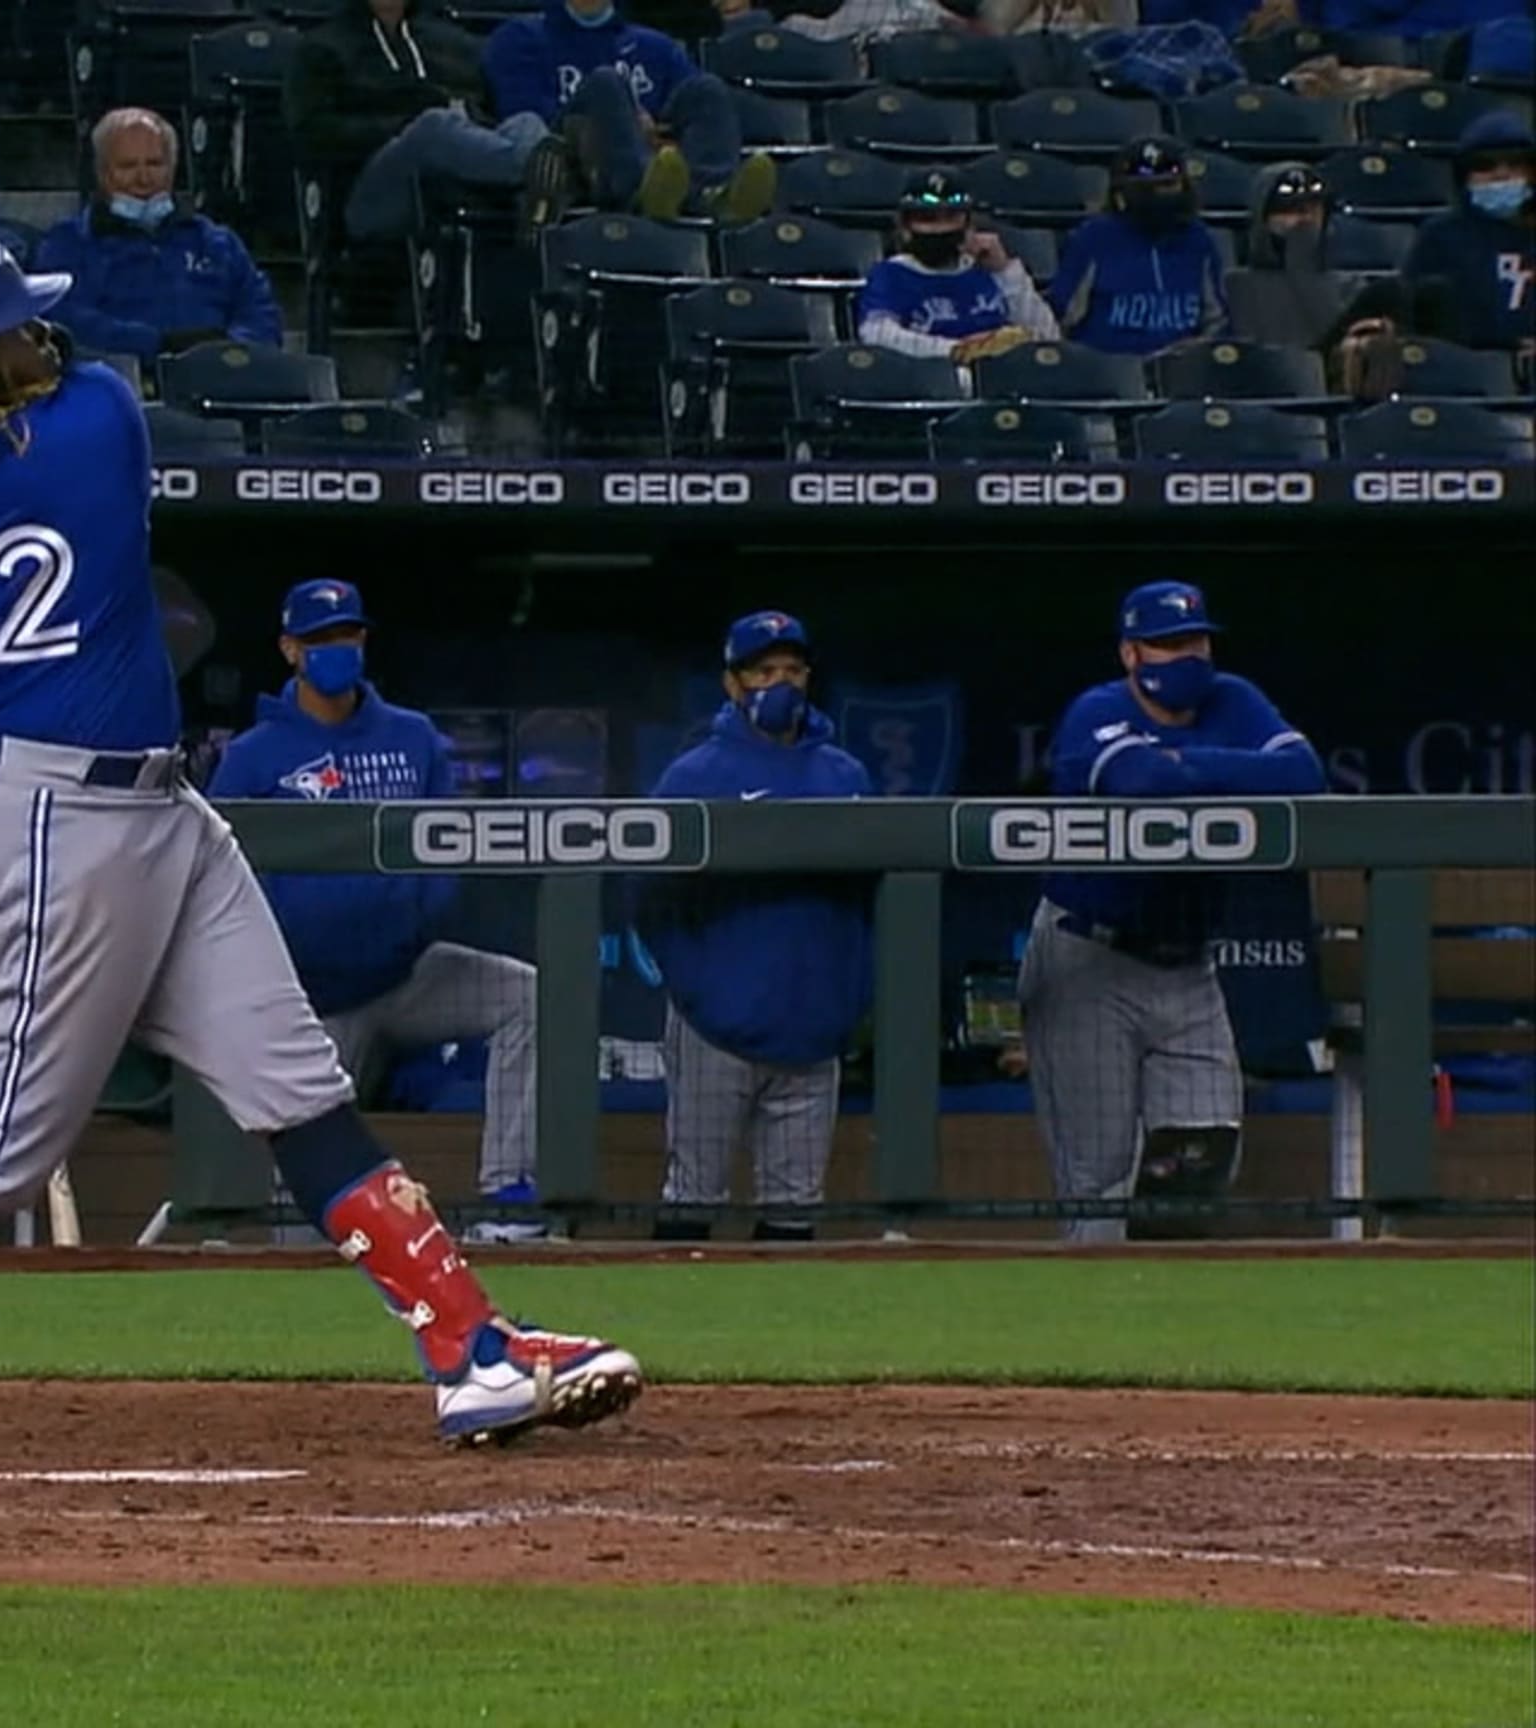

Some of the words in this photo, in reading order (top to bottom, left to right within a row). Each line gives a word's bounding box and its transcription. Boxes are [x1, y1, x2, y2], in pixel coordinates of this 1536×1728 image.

[236, 469, 381, 502] GEICO
[420, 472, 564, 503] GEICO
[603, 473, 750, 504] GEICO
[790, 474, 937, 504] GEICO
[977, 474, 1125, 504] GEICO
[1166, 472, 1313, 503] GEICO
[1354, 471, 1503, 502] GEICO
[413, 808, 671, 864] GEICO
[990, 807, 1257, 862] GEICO
[1212, 939, 1307, 967] nsas
